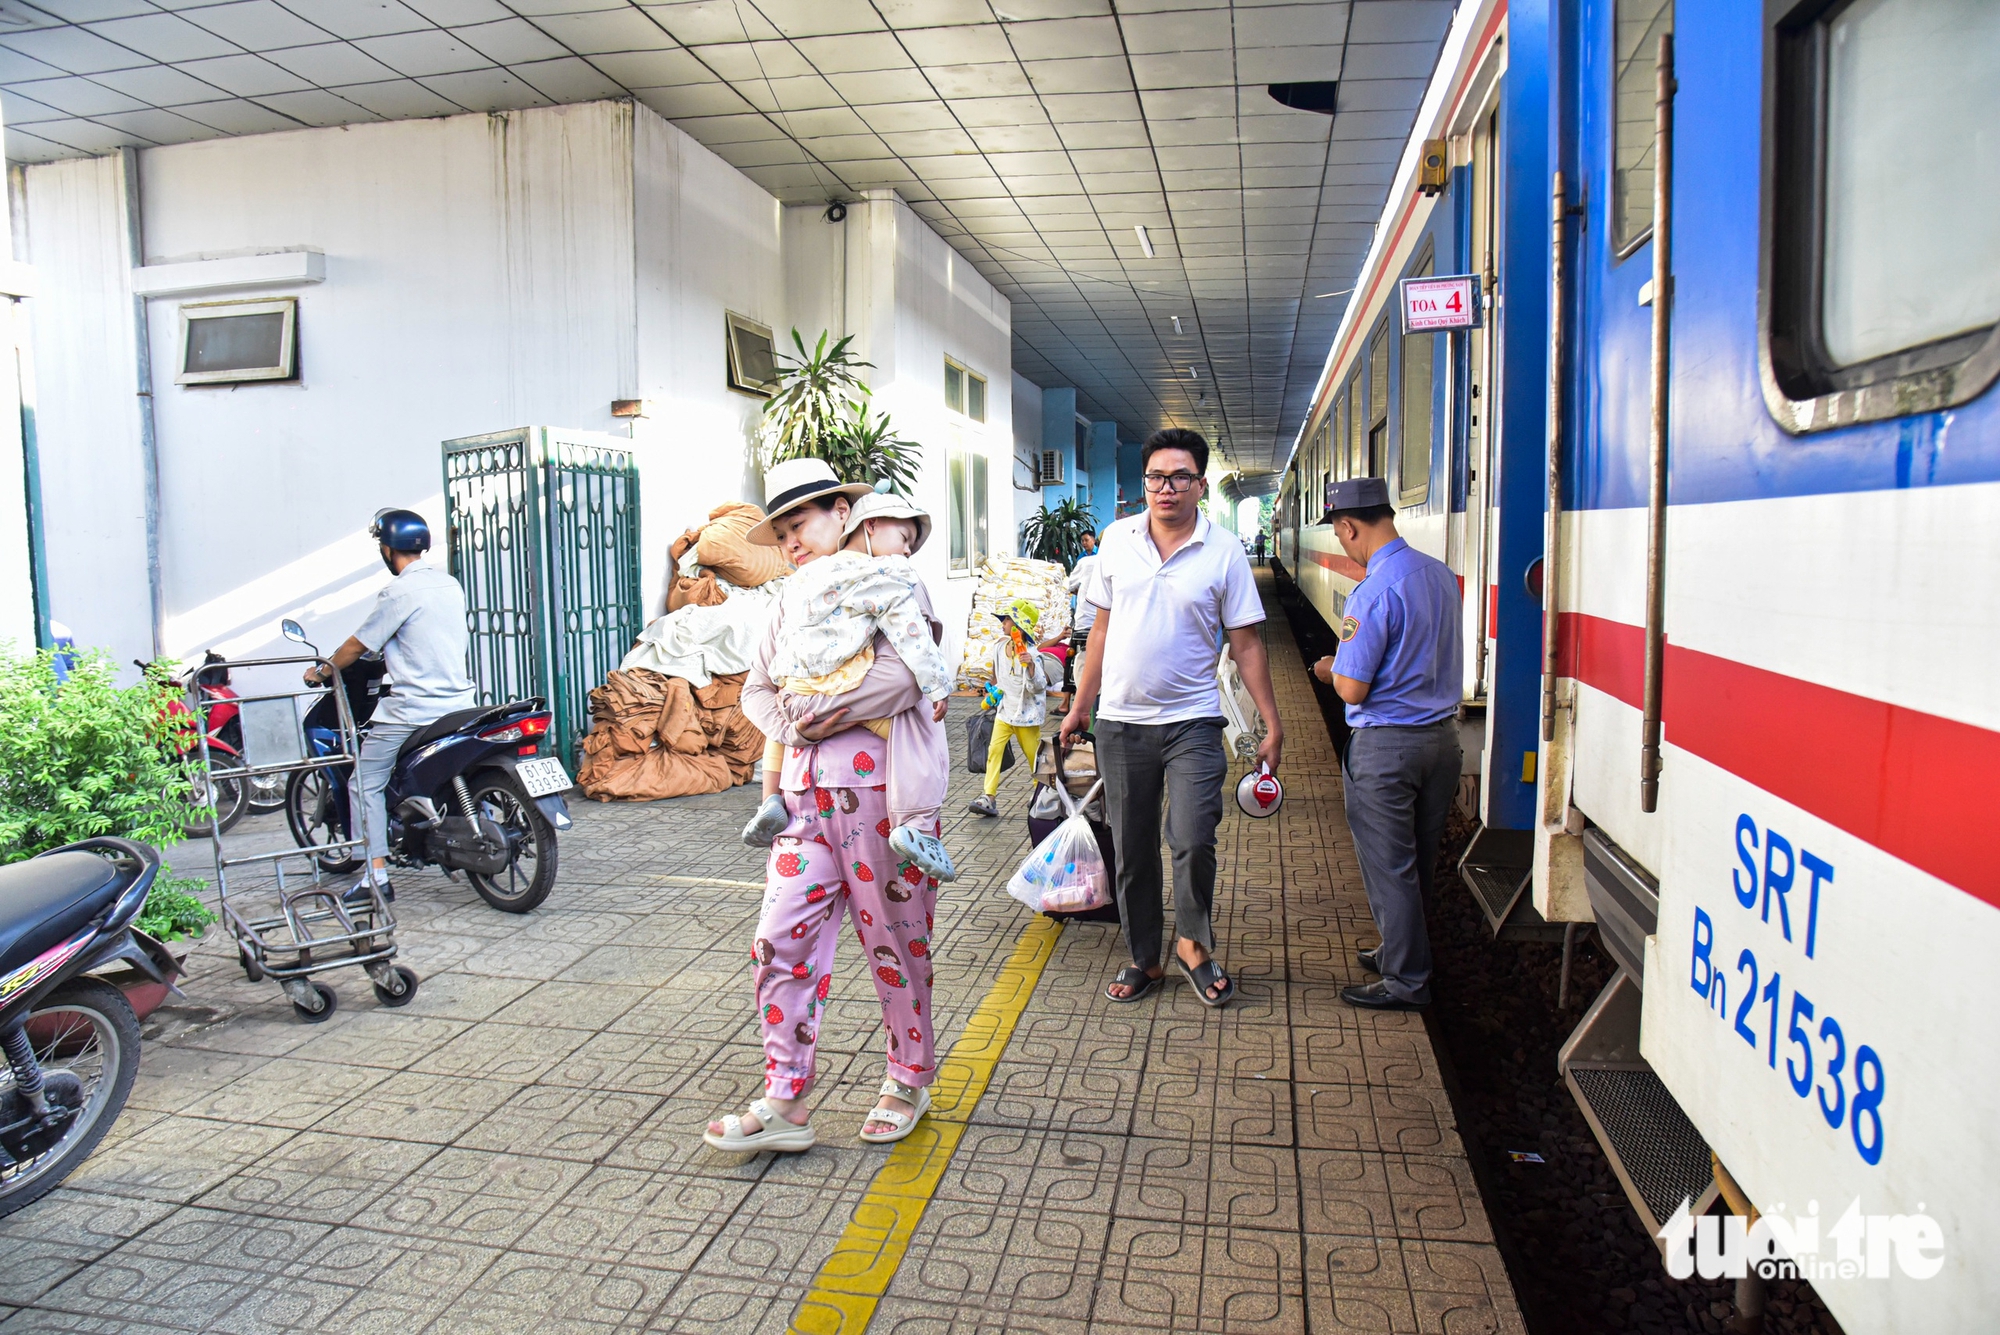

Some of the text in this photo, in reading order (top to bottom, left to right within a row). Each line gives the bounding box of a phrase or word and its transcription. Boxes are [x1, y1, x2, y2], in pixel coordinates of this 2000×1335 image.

[1446, 291, 1462, 313] 4
[1437, 318, 1448, 326] Quý
[527, 774, 568, 793] 339.56
[1732, 813, 1834, 960] SRT
[1690, 905, 1885, 1166] Bn 21538
